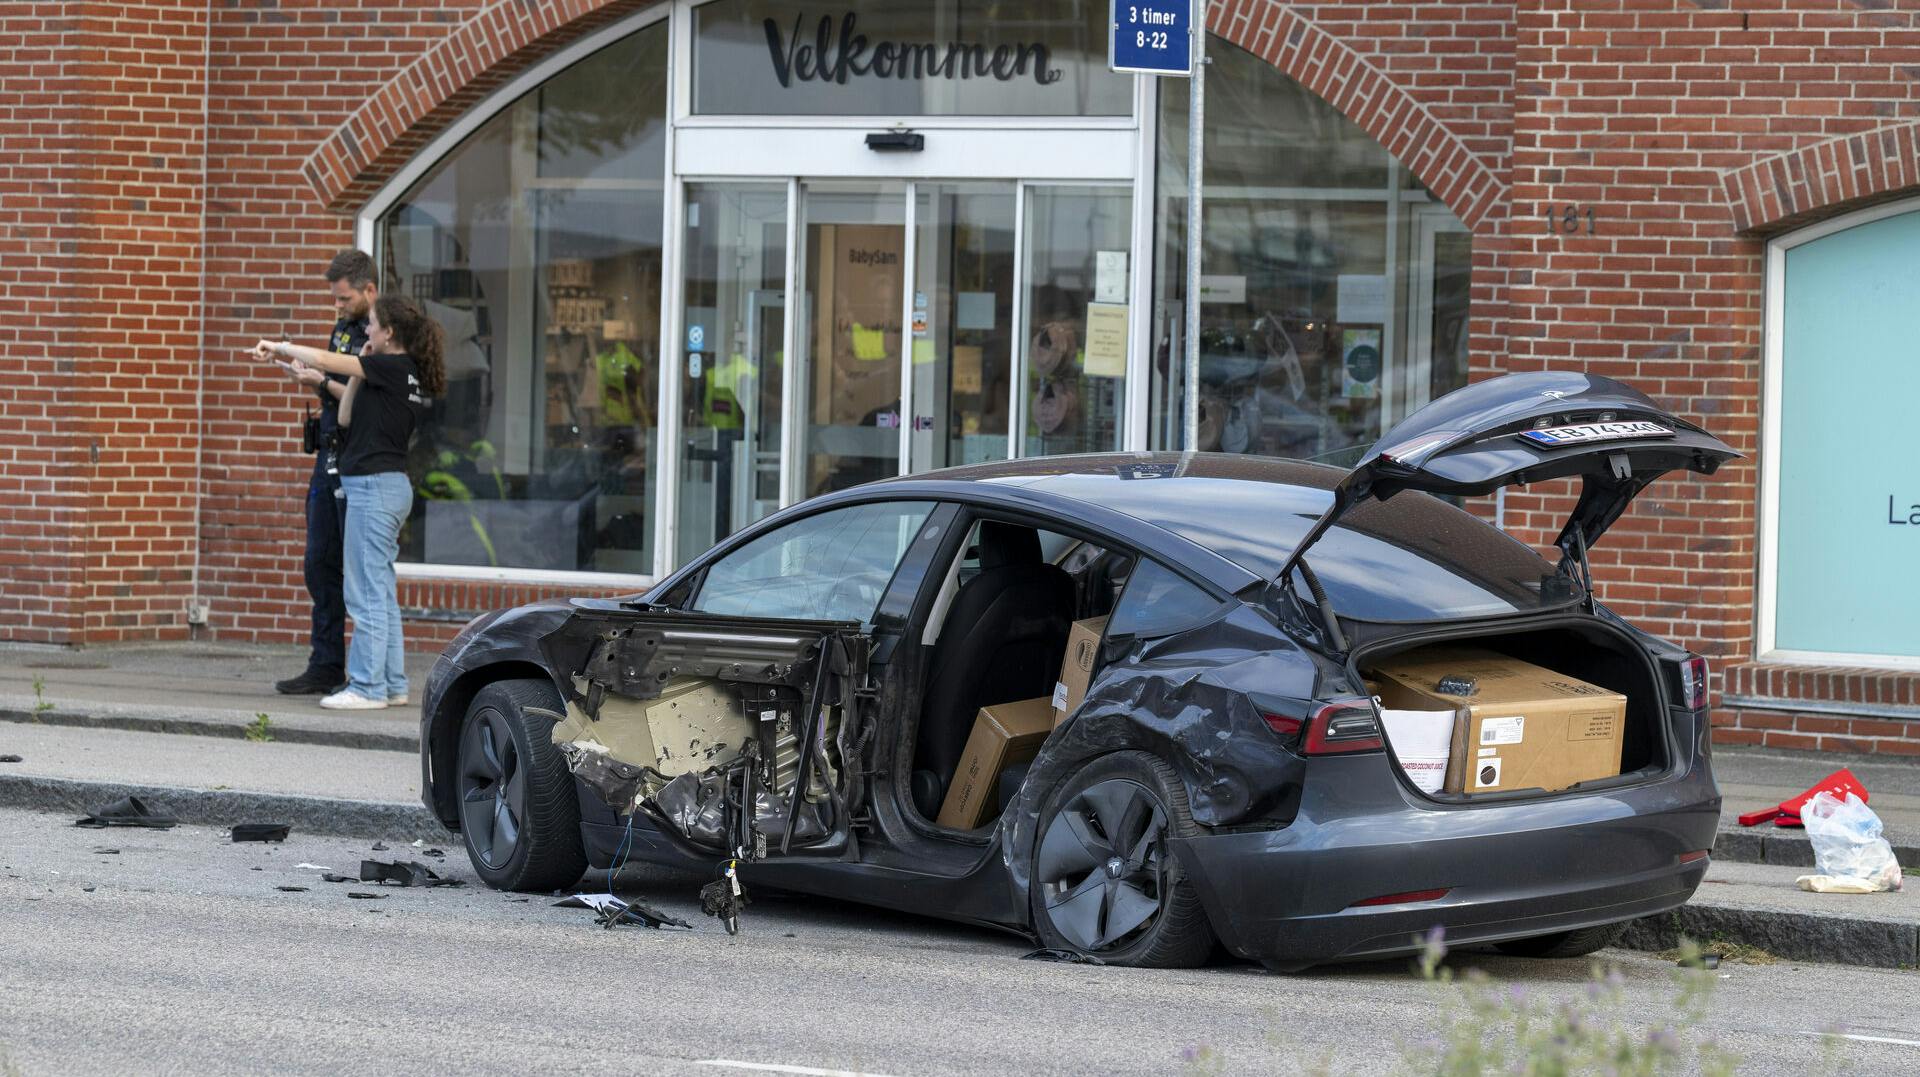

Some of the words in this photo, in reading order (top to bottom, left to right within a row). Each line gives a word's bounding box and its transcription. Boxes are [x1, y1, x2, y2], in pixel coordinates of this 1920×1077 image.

[1129, 6, 1137, 23] 3
[1142, 7, 1176, 25] timer
[1136, 30, 1167, 49] 8-22
[763, 12, 1063, 88] Velkommen
[1545, 205, 1594, 234] 181
[849, 248, 897, 267] BabySam
